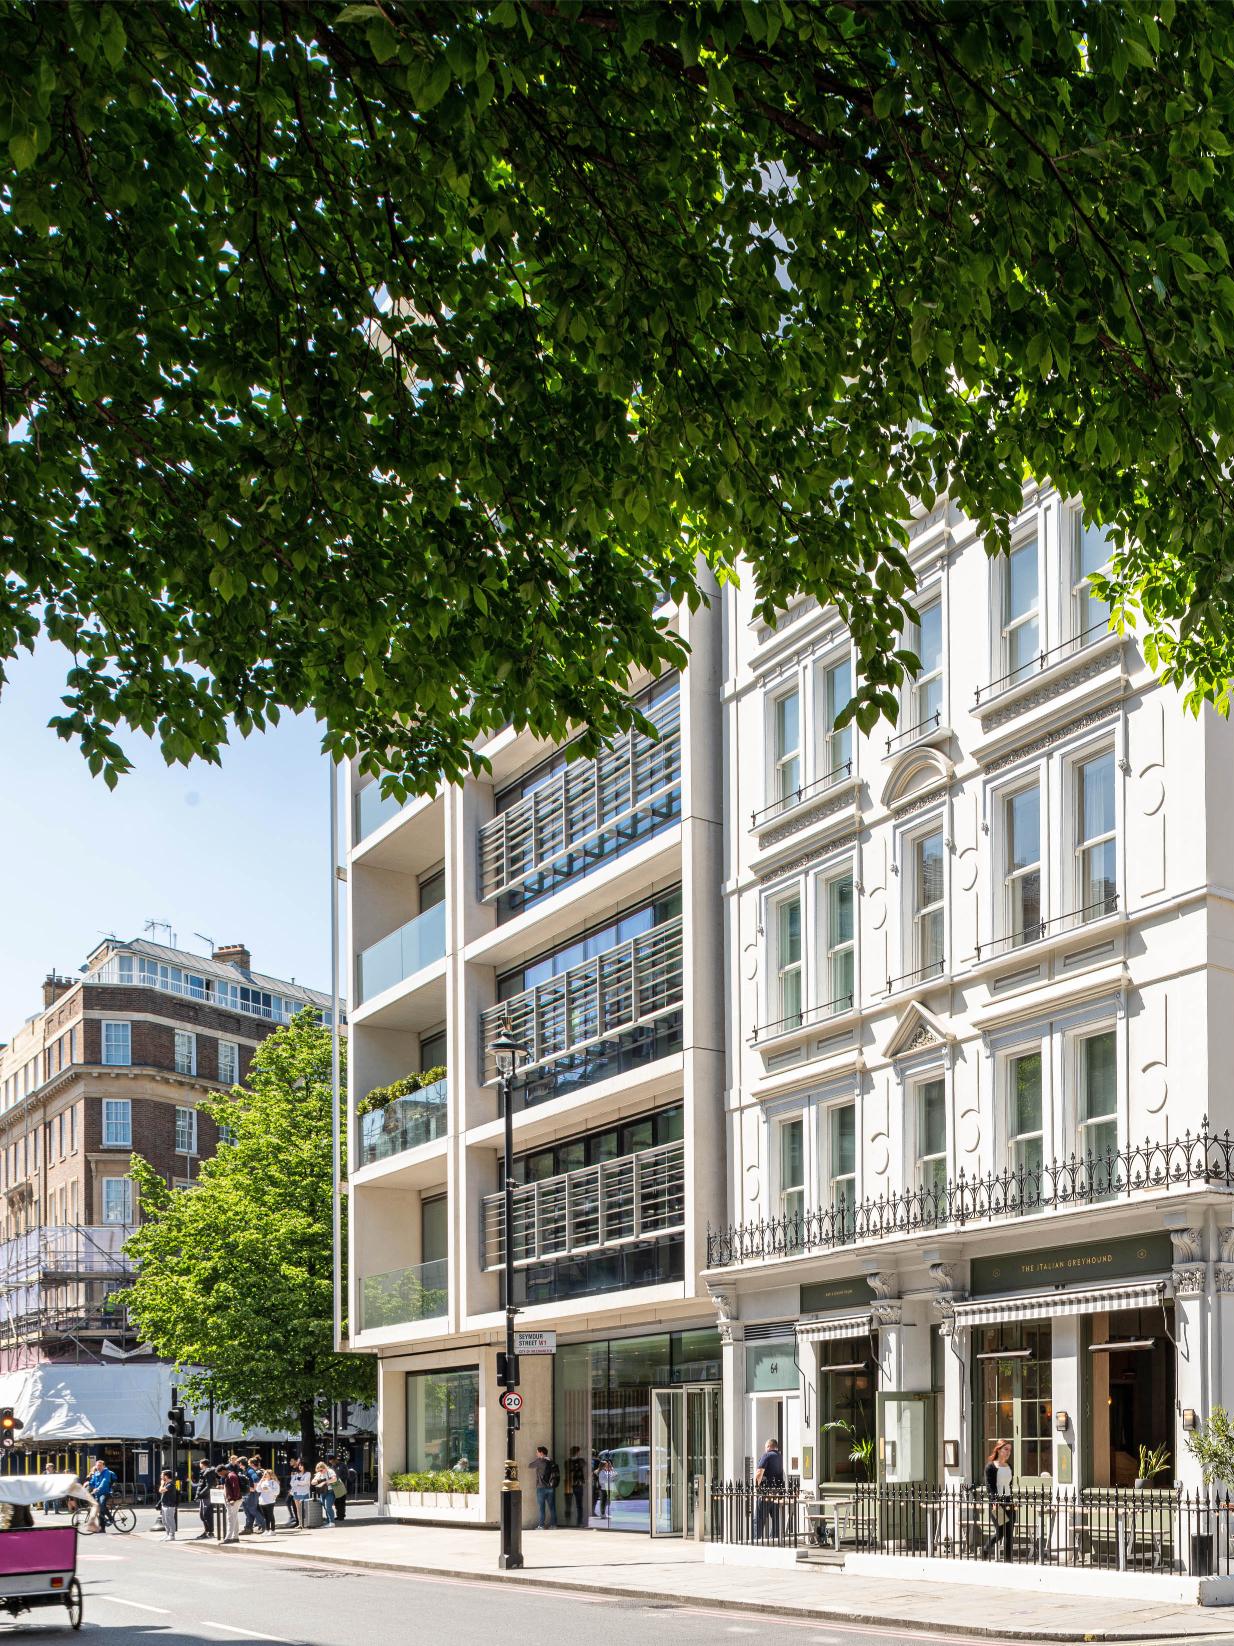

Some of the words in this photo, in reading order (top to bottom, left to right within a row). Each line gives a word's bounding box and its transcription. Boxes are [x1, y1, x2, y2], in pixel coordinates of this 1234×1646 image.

[1022, 1264, 1034, 1272] THE
[1037, 1262, 1064, 1272] ITALIAN
[1067, 1254, 1113, 1267] GREYHOUND
[770, 1362, 778, 1374] 64
